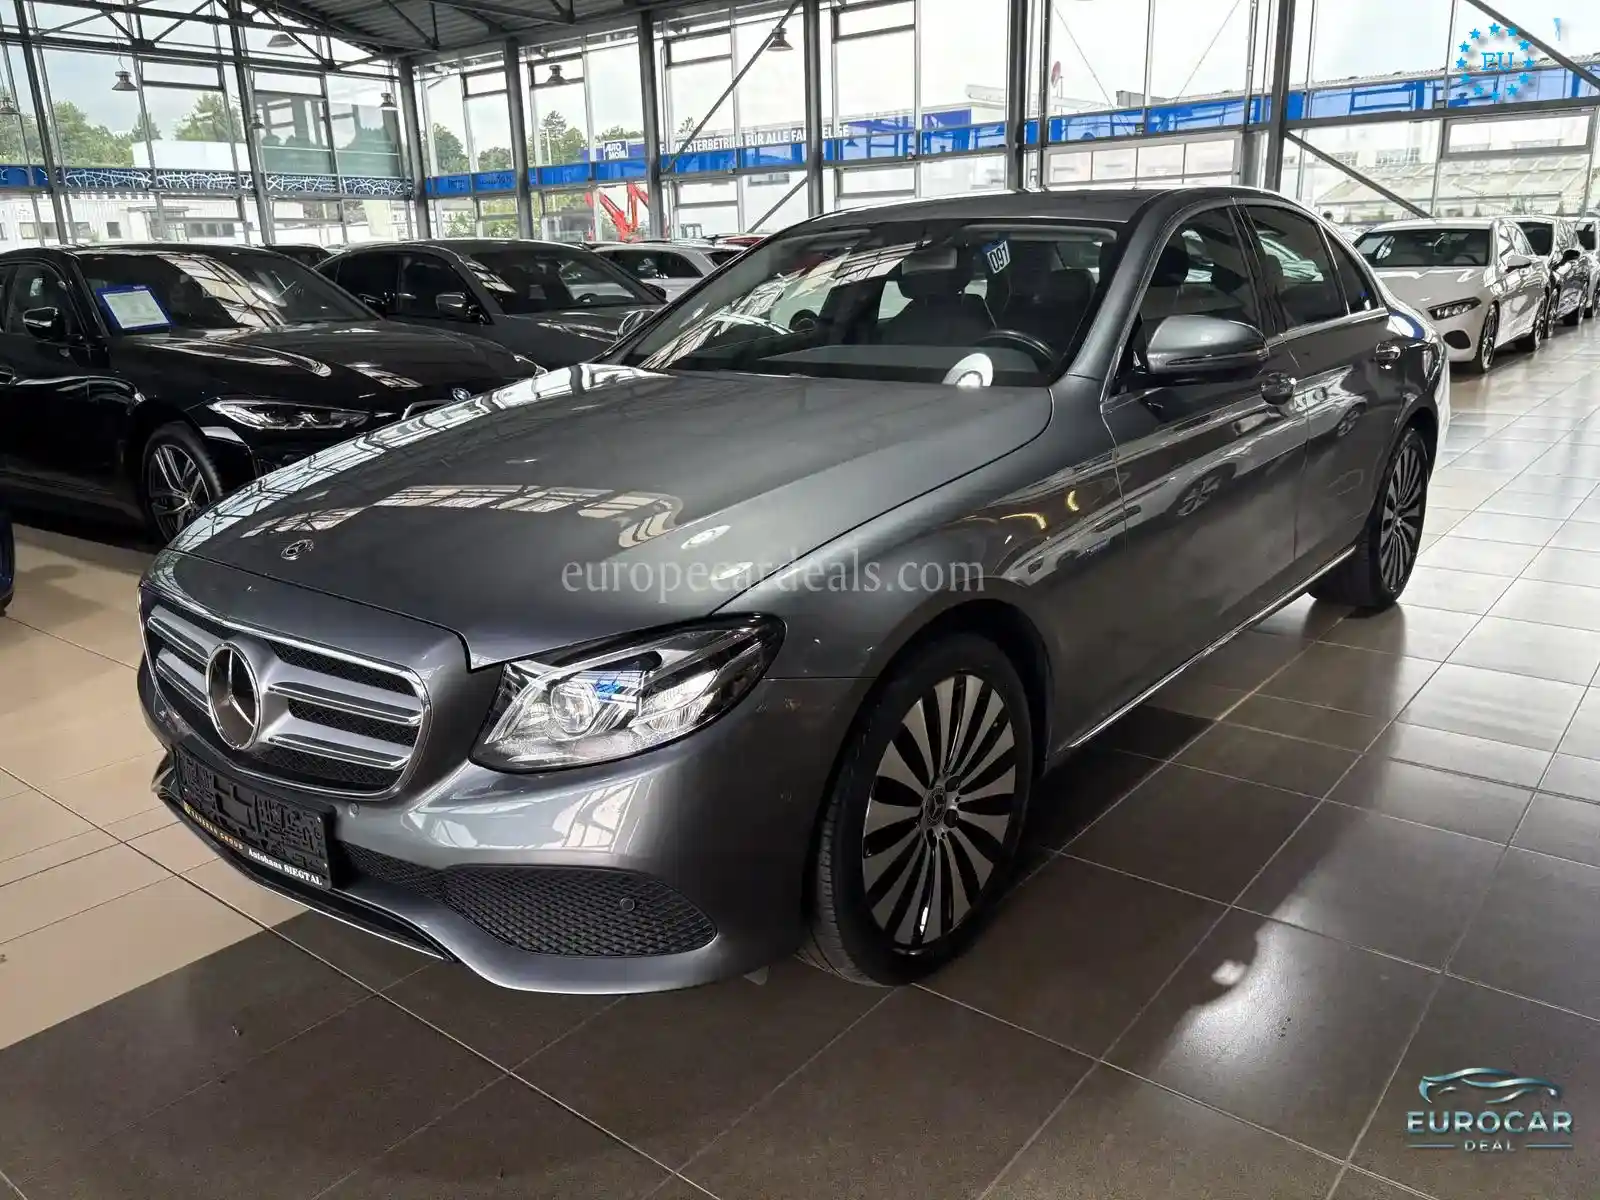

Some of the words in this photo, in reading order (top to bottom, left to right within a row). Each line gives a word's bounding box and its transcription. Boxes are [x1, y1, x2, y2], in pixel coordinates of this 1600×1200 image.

[675, 135, 743, 153] MESTERBETRI
[766, 130, 789, 145] ALLE
[248, 848, 282, 870] Autohaus
[283, 864, 323, 886] SIEGTAL
